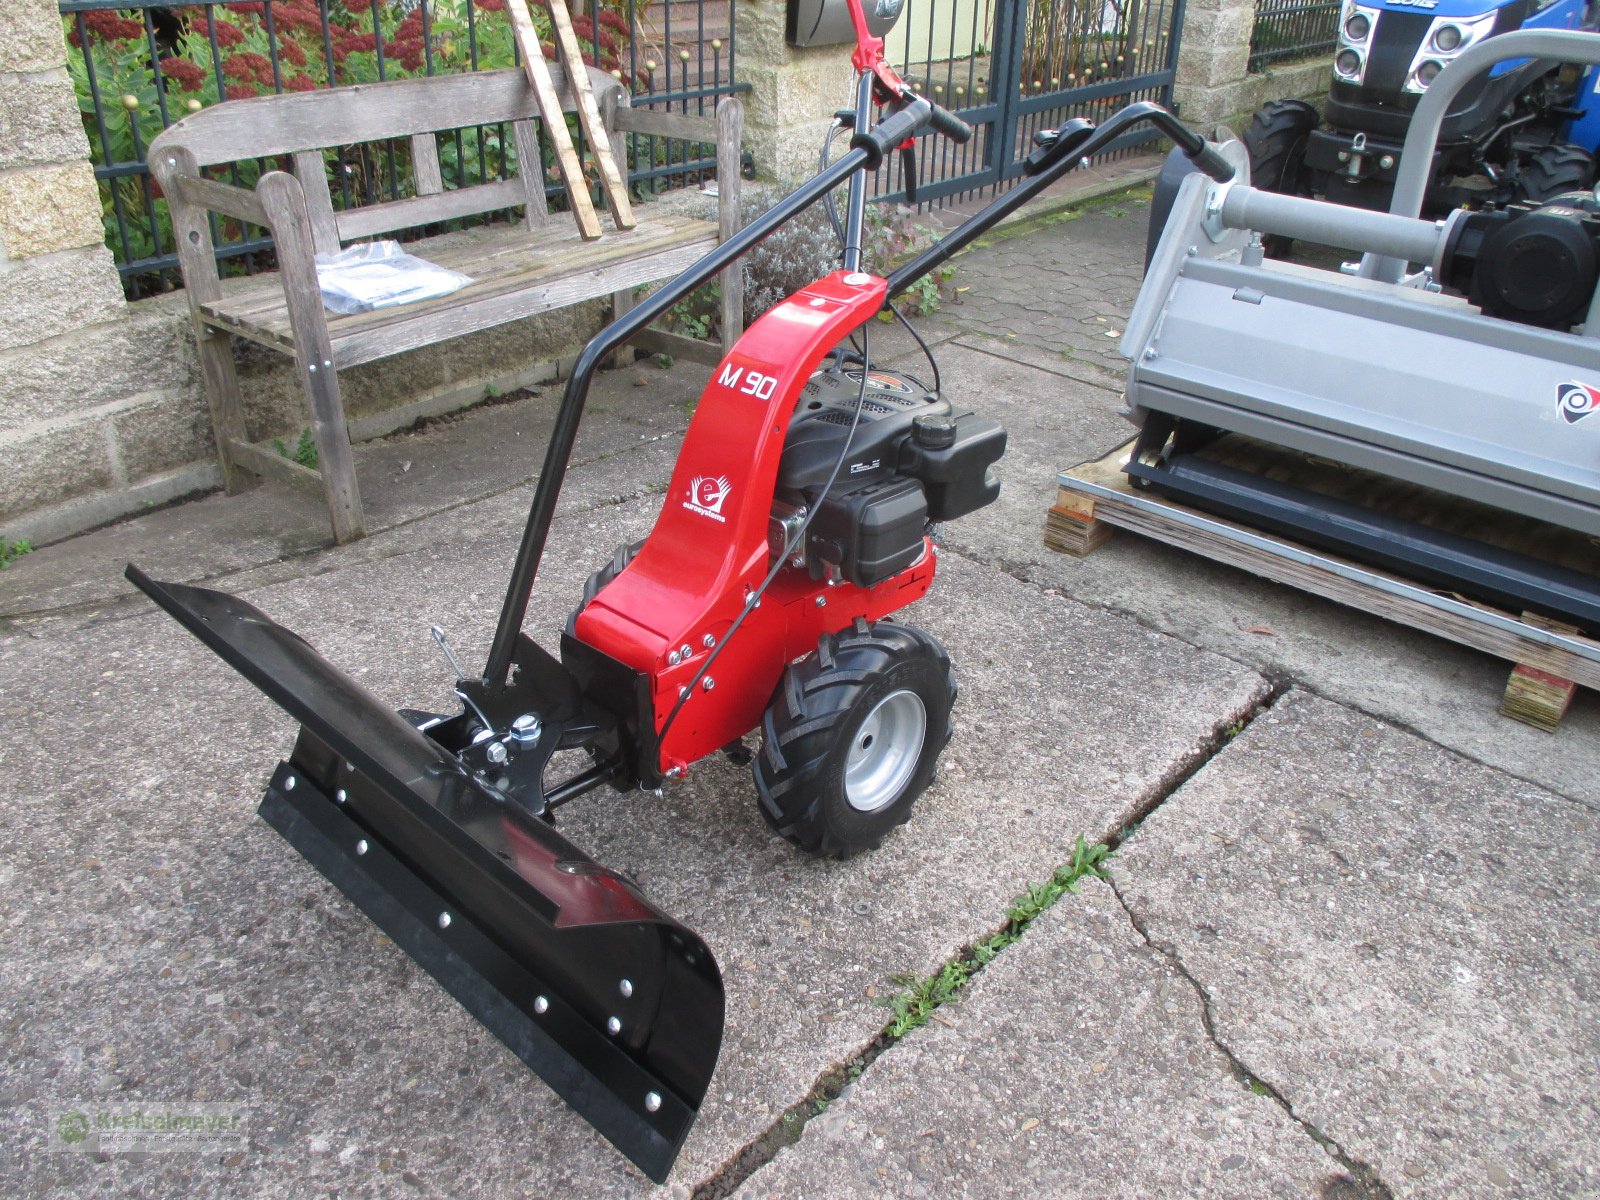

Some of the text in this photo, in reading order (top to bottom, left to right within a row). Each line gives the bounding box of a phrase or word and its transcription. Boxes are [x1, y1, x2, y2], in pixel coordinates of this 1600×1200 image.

[717, 362, 778, 400] M 90
[682, 501, 726, 523] eurosystems
